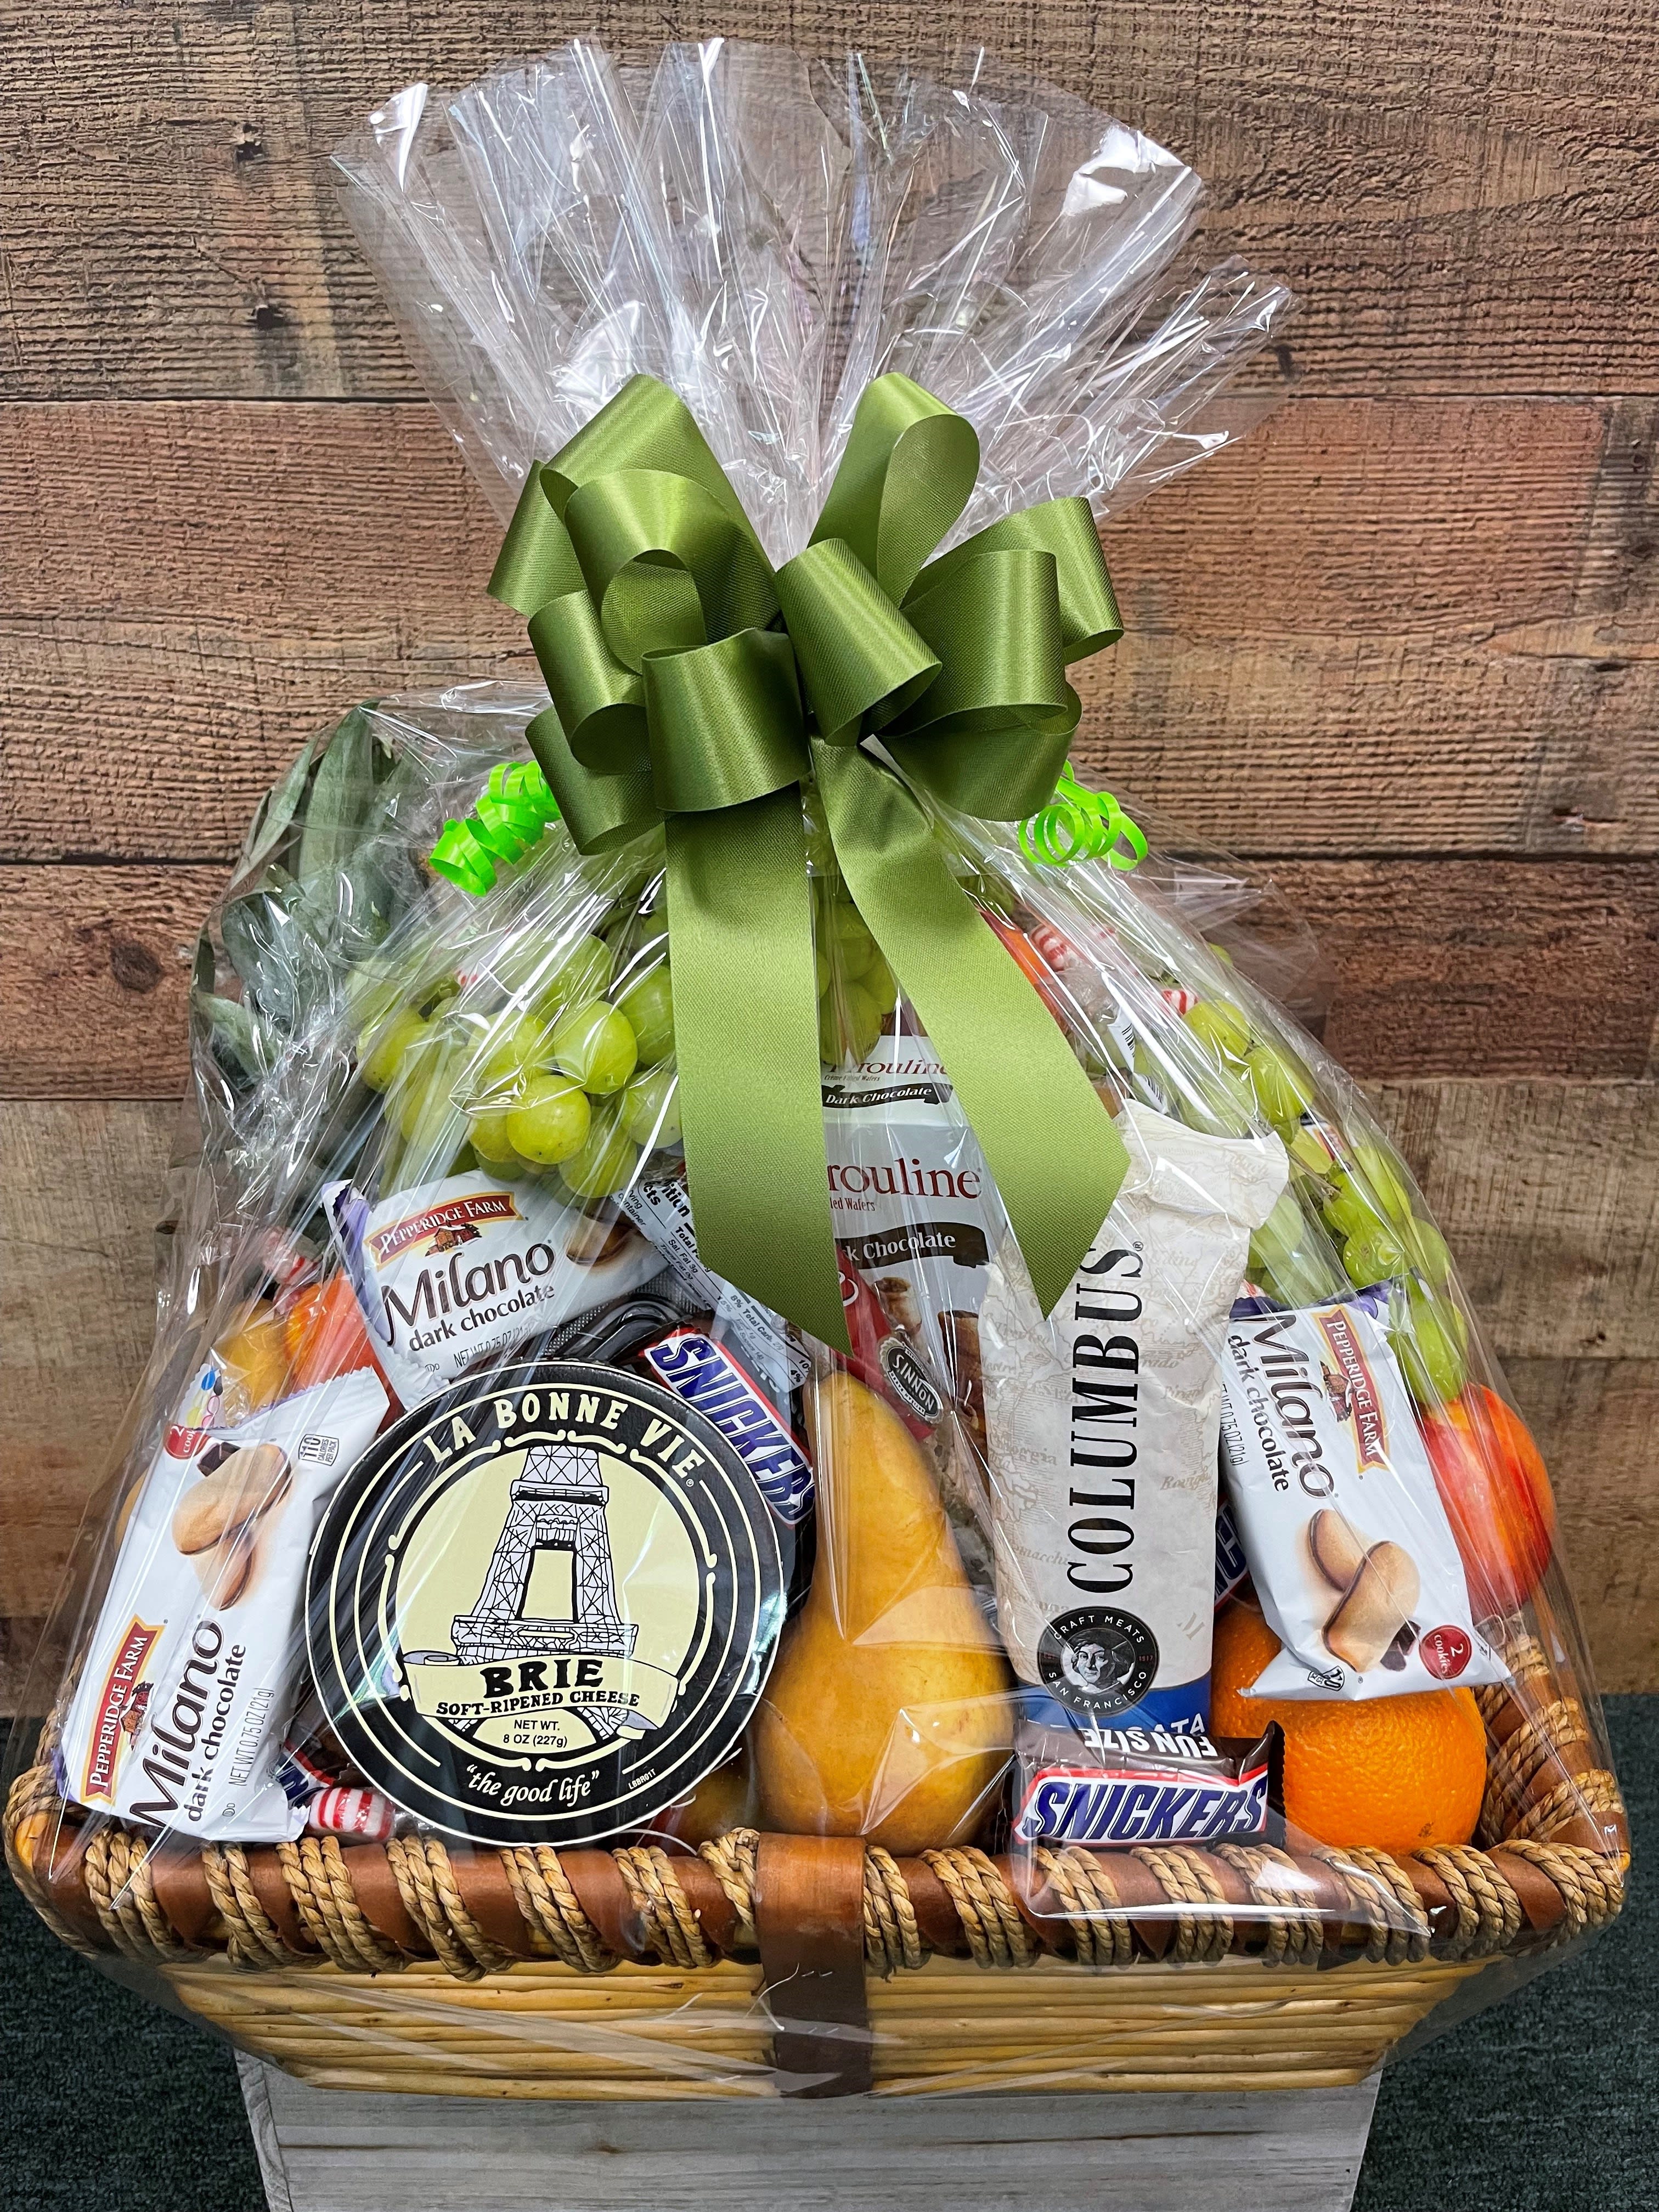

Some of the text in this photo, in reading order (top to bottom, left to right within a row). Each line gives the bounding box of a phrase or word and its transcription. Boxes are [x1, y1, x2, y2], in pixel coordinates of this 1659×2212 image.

[828, 1059, 947, 1075] roulin
[826, 1087, 932, 1104] Dark Chocolate
[827, 1157, 980, 1199] rouline
[618, 1192, 647, 1227] cntainer
[830, 1198, 875, 1211] led Wafers
[379, 1198, 507, 1254] PEPPERIDGE FARM
[675, 1226, 695, 1249] Total
[863, 1233, 956, 1259] Chocolate
[381, 1241, 556, 1346] Milano
[730, 1295, 744, 1308] 8%
[409, 1284, 555, 1351] dark chocolate
[743, 1308, 760, 1327] Total
[454, 1348, 470, 1368] NET
[791, 1369, 803, 1383] 4%
[892, 1354, 934, 1412] NONNI'S
[1327, 1321, 1379, 1457] PEPPERIDGE FARM
[1067, 1248, 1143, 1593] COLUMBUS
[1228, 1334, 1289, 1492] dark chocolate
[1230, 1314, 1335, 1498] Milano
[300, 1436, 321, 1457] 110
[423, 1392, 706, 1479] LA BONNE VIE
[650, 1337, 816, 1521] SNICKERS
[317, 1438, 329, 1461] CALORIES
[325, 1440, 337, 1463] PER PACK
[1053, 1615, 1145, 1643] CRAFT MEATS
[1434, 1634, 1464, 1674] 2 cookies
[479, 1659, 604, 1699] BRIE
[1048, 1671, 1147, 1709] SAN FRANCISCO
[89, 1635, 148, 1787] PEPPERIDGE FARM
[436, 1690, 641, 1715] SOFT-RIPENED CHEESE
[129, 1619, 223, 1828] Milano
[188, 1644, 246, 1822] dark chocolate
[228, 1688, 275, 1787] NET WT 0.75 OZ (21g)
[503, 1734, 568, 1748] 8 OZ (227g)
[514, 1719, 560, 1731] NET WT.
[1078, 1728, 1218, 1758] FUN SIZE
[500, 1779, 559, 1808] good
[1024, 1775, 1267, 1841] SNICKERS
